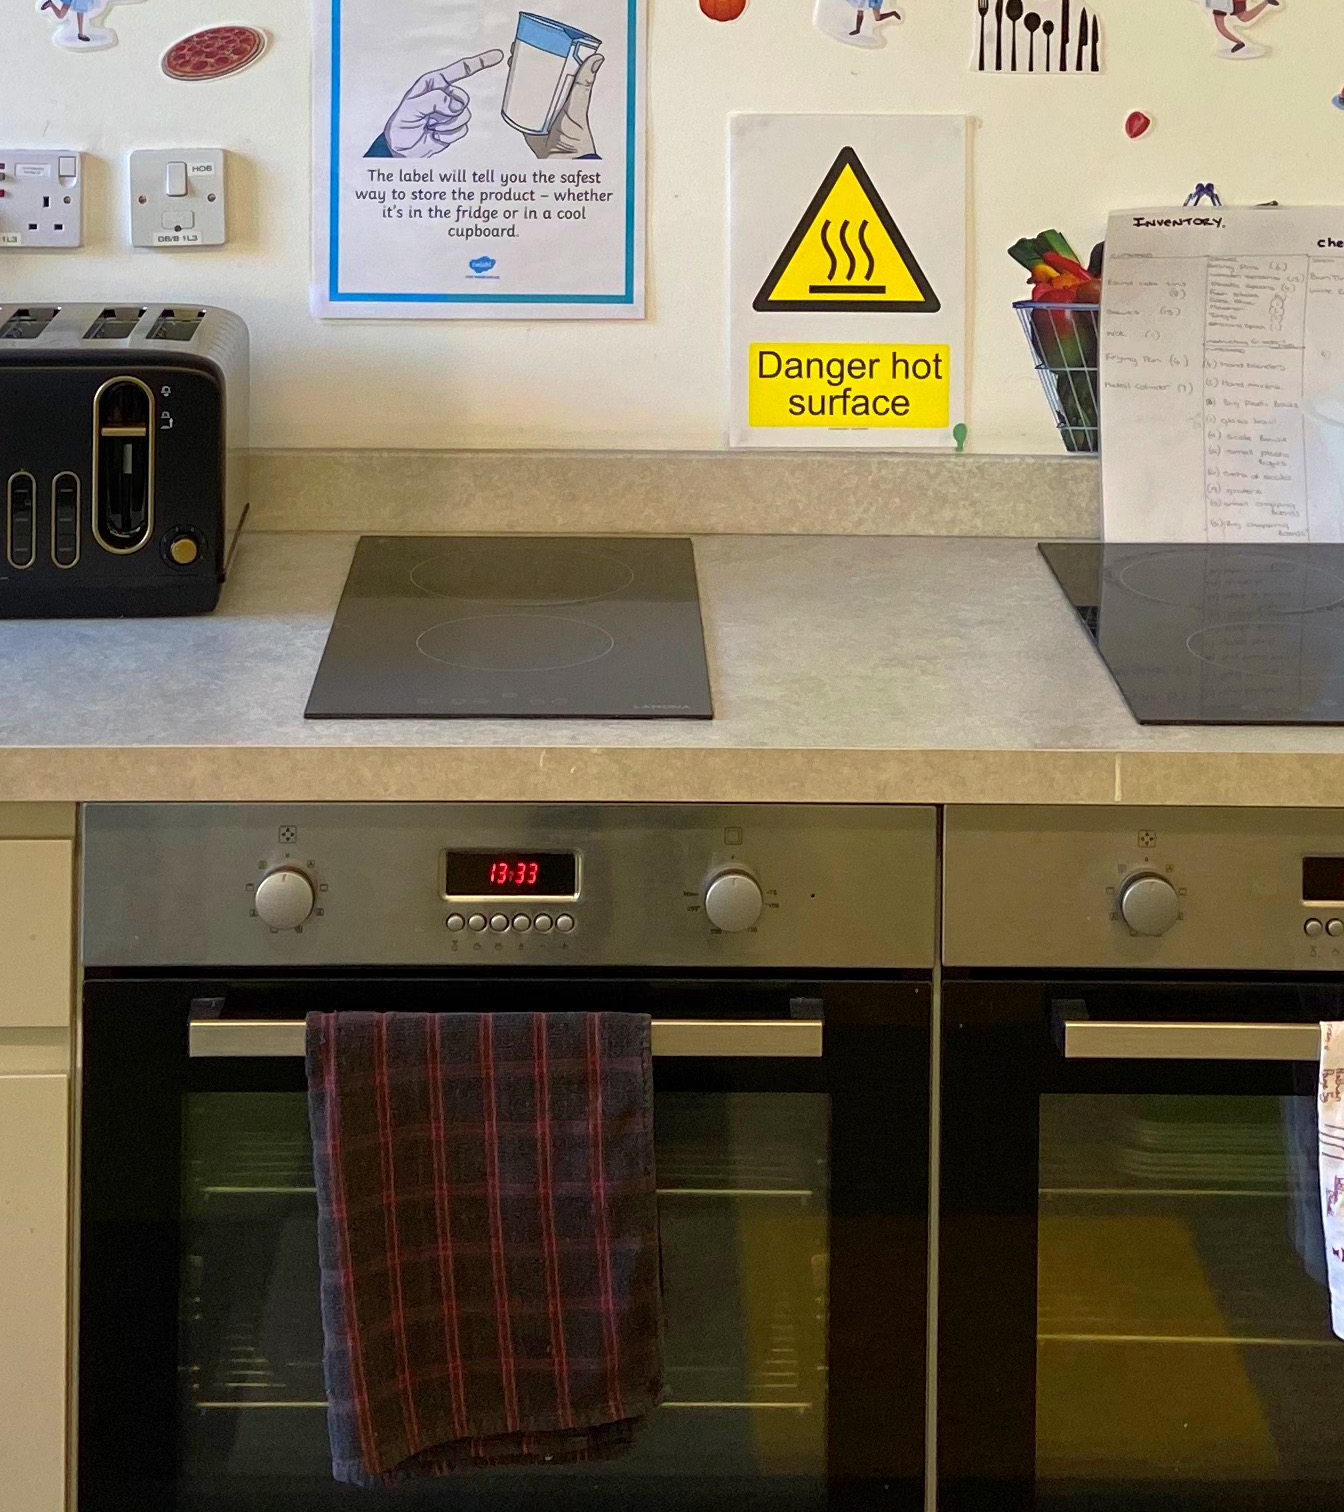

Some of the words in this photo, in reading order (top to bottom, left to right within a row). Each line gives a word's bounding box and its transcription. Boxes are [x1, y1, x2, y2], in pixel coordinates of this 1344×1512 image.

[192, 164, 212, 173] HOB
[368, 169, 393, 183] The
[399, 169, 434, 183] label
[439, 169, 466, 183] will
[472, 169, 494, 183] tell
[500, 173, 527, 187] you
[532, 170, 555, 184] the
[560, 169, 601, 187] safest
[355, 190, 386, 203] way
[392, 189, 406, 201] to
[411, 189, 446, 201] store
[452, 188, 475, 201] the
[479, 188, 535, 203] product
[554, 188, 613, 202] whether
[409, 206, 423, 219] in
[428, 206, 451, 219] the
[455, 205, 498, 222] fridge
[503, 209, 519, 220] or
[524, 206, 537, 220] in
[542, 209, 552, 220] a
[557, 206, 586, 220] cool
[448, 224, 520, 240] cupboard.
[758, 350, 880, 386] Danger
[891, 351, 943, 380] hot
[788, 387, 910, 416] surface
